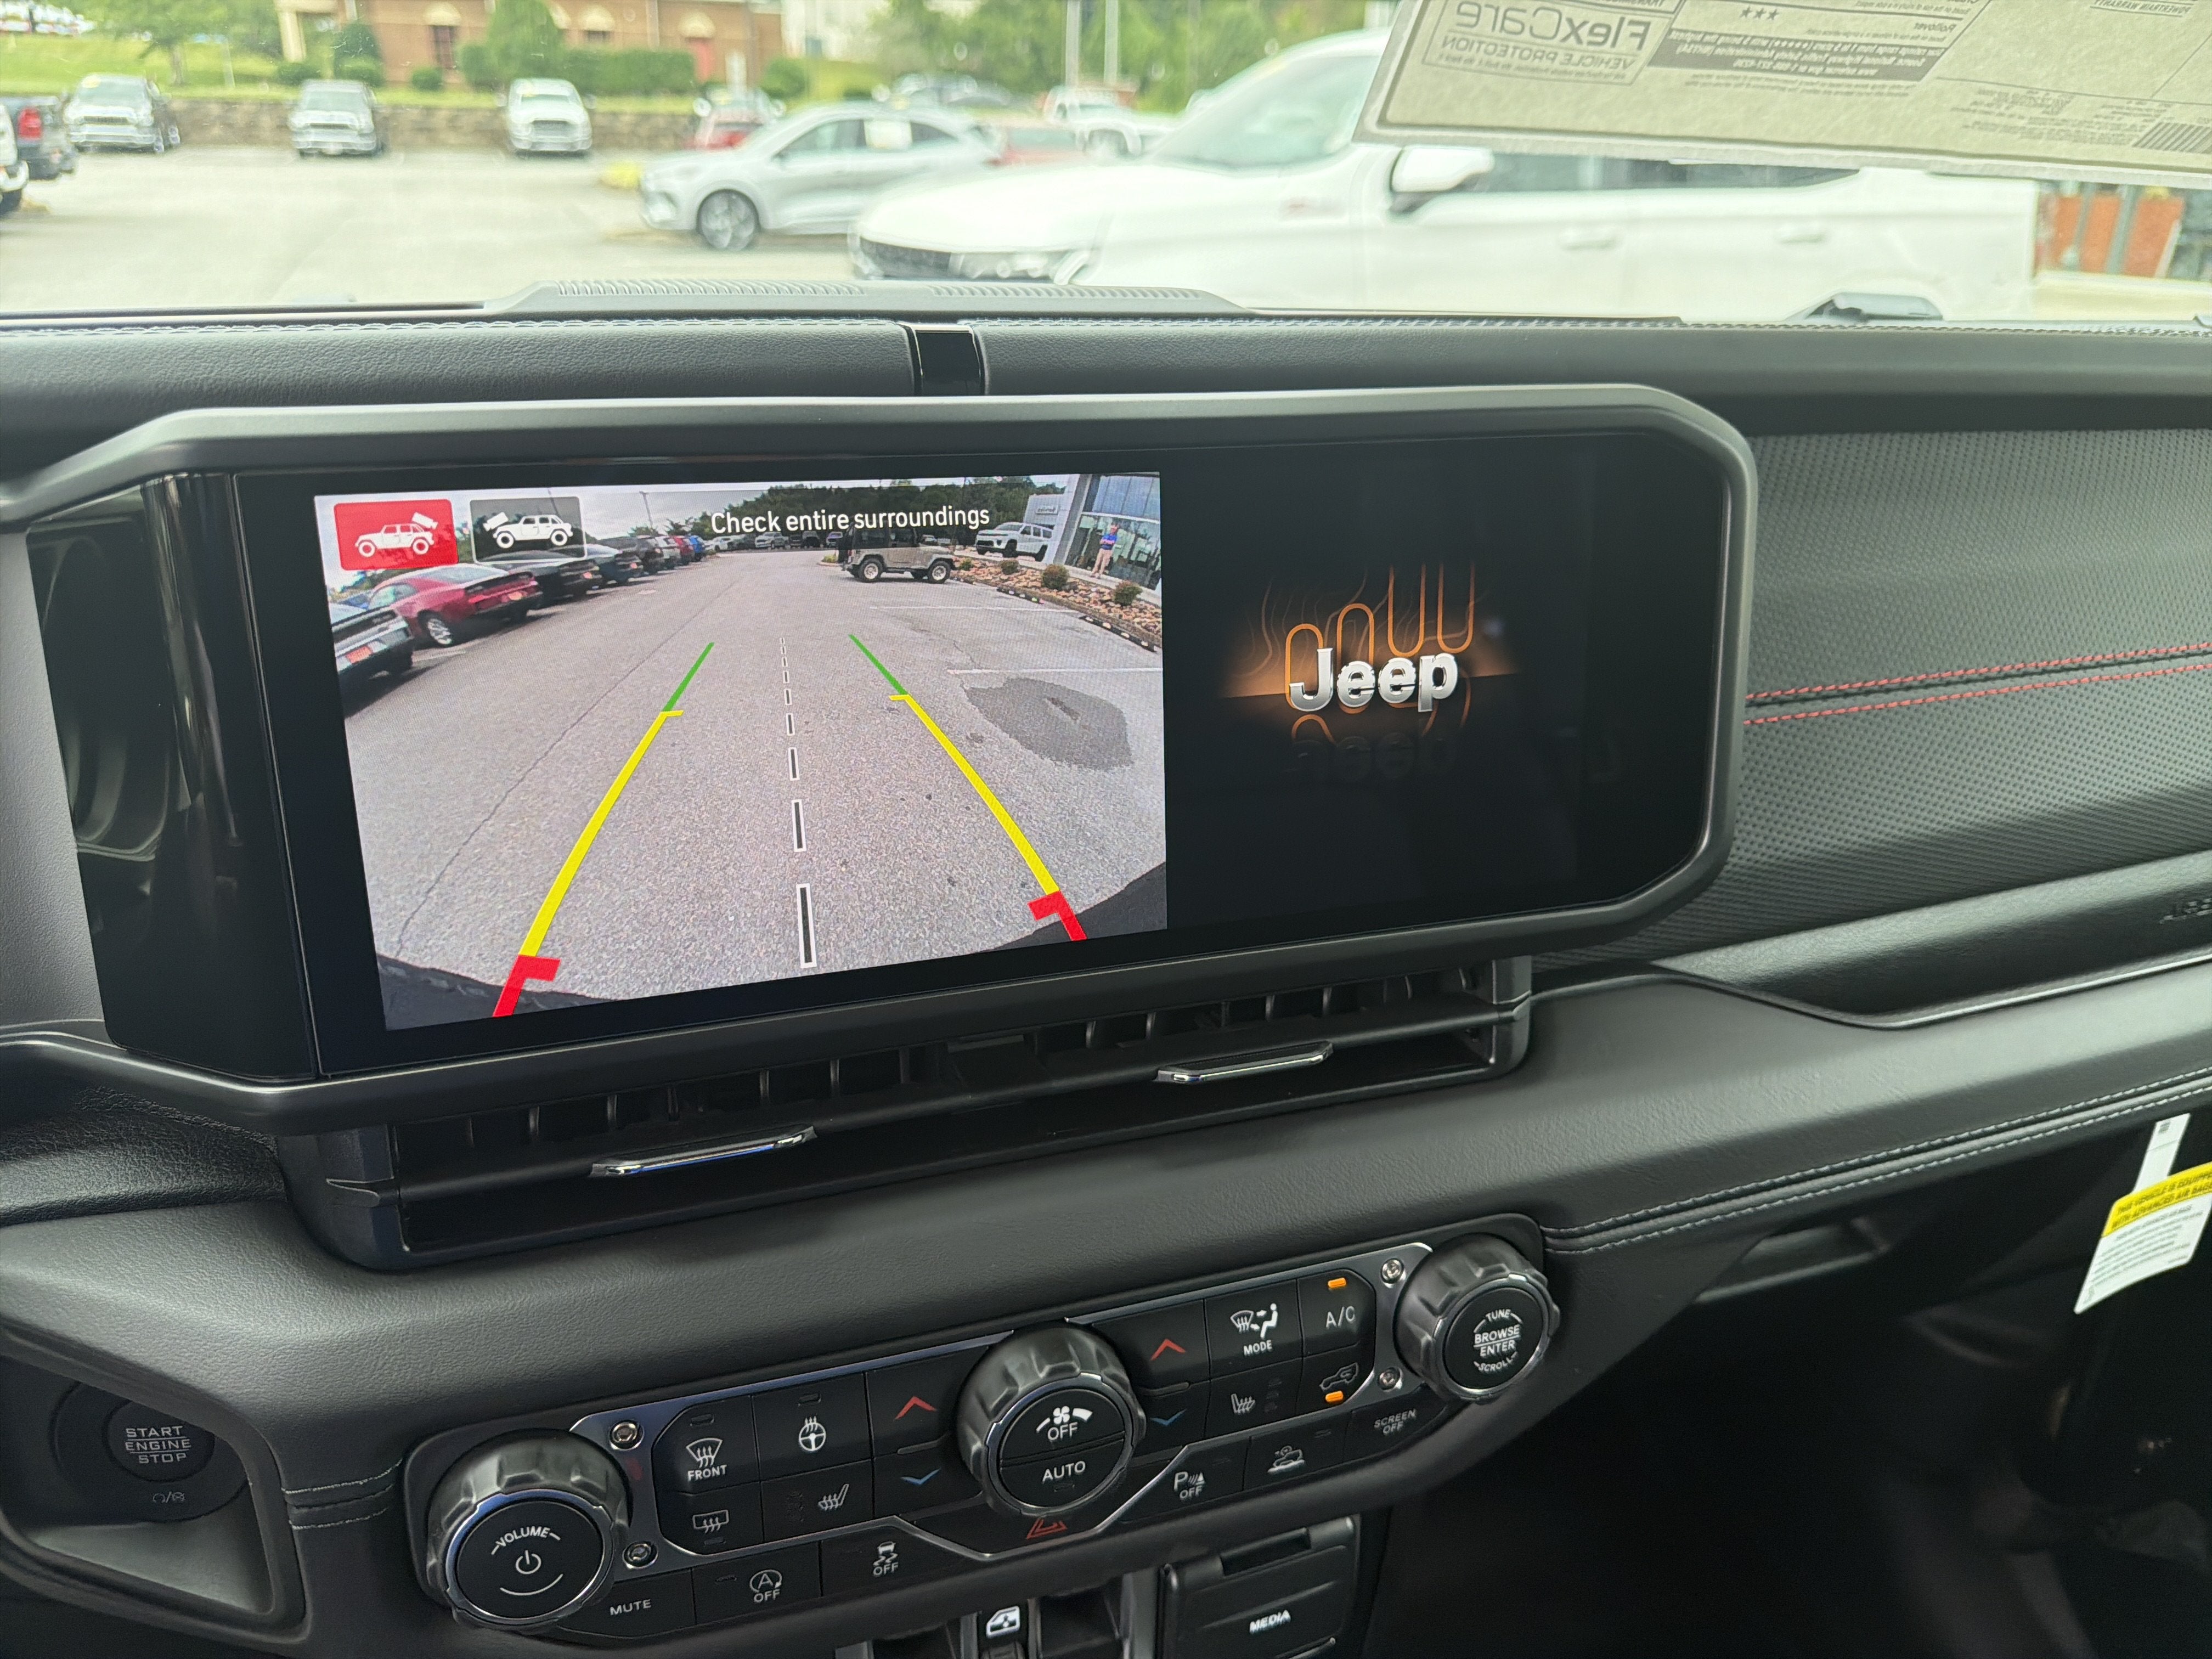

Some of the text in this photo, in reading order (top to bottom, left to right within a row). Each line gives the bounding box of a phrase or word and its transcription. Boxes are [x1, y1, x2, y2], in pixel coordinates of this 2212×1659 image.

[711, 505, 990, 534] Check entire surroundings
[1289, 648, 1458, 712] Jeep
[1326, 1306, 1356, 1329] A/C
[1486, 1308, 1511, 1322] TUNE
[1474, 1324, 1520, 1342] BROWSE
[1244, 1340, 1272, 1356] MODE
[1479, 1339, 1515, 1358] ENTER
[1478, 1356, 1514, 1372] SCROLL
[1374, 1408, 1417, 1429] SCREEN
[126, 1425, 183, 1438] START
[1047, 1423, 1078, 1441] OFF
[1383, 1421, 1403, 1436] OFF
[125, 1439, 191, 1451] ENGINE
[138, 1452, 187, 1464] STOP
[688, 1464, 727, 1481] FRONT
[1042, 1461, 1086, 1483] AUTO
[1180, 1485, 1203, 1500] OFF
[496, 1526, 550, 1548] VOLUME
[873, 1562, 899, 1576] OFF
[754, 1589, 780, 1602] OFF
[610, 1599, 652, 1615] MUTE
[1249, 1610, 1291, 1634] MEDIA
